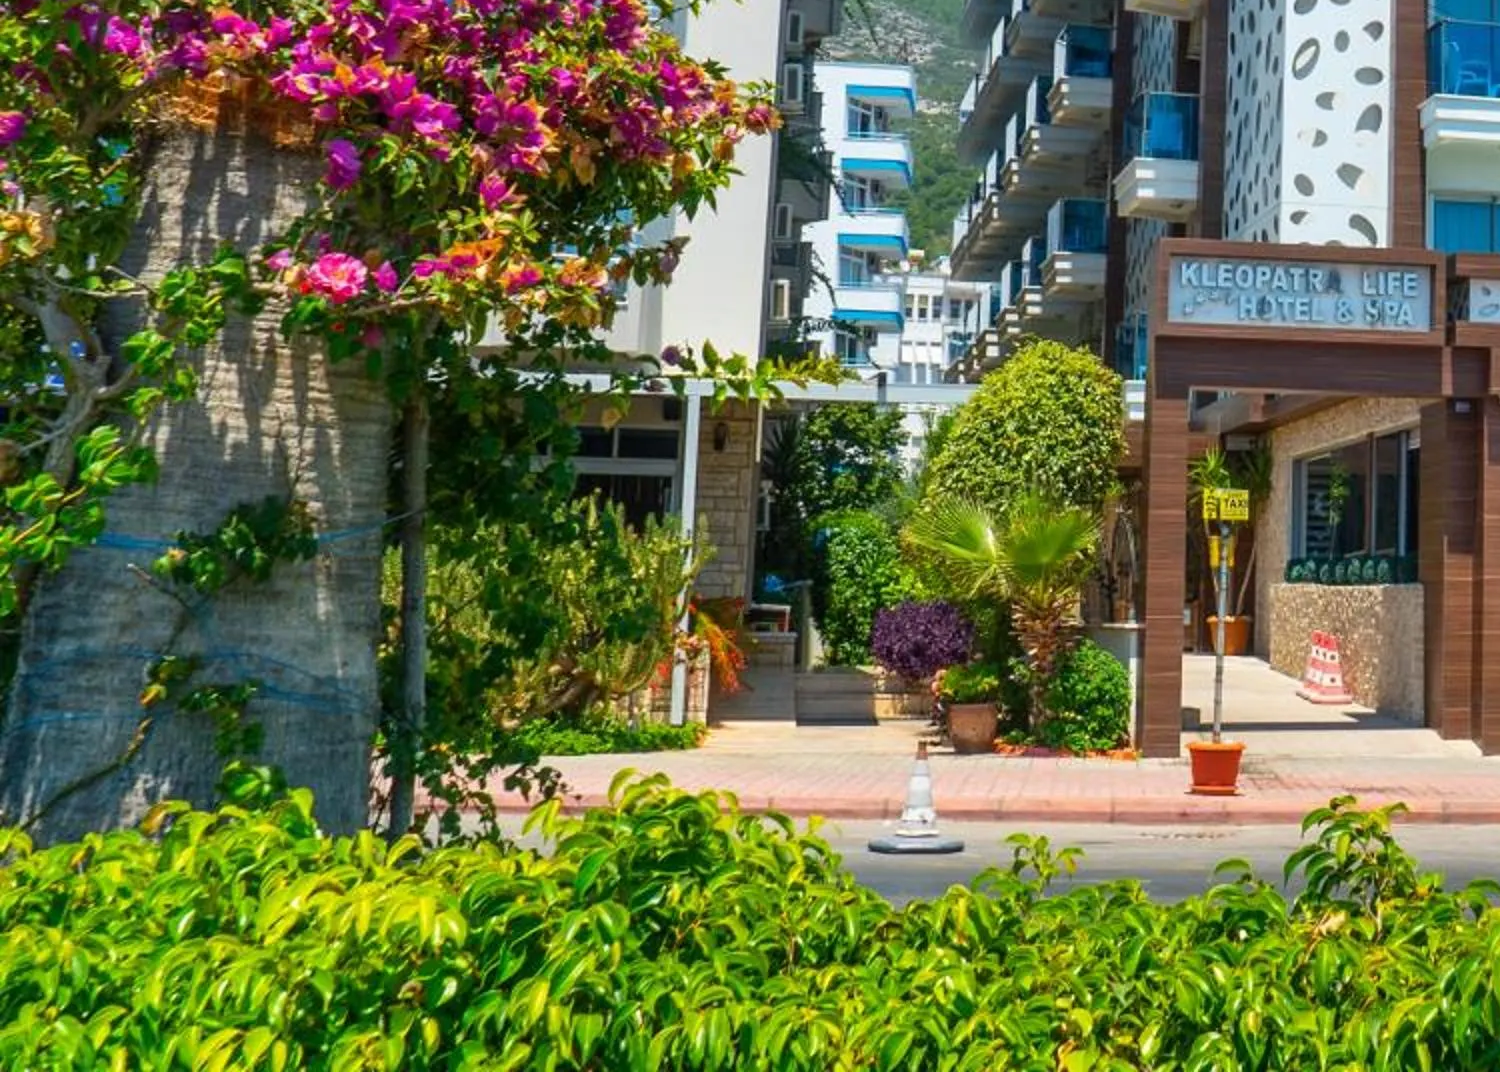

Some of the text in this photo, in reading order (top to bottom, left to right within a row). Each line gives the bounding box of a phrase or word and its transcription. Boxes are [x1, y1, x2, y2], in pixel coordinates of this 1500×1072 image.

[1180, 262, 1418, 297] KLEOPATRA LIFE
[1238, 295, 1414, 326] HOTEL & SPA
